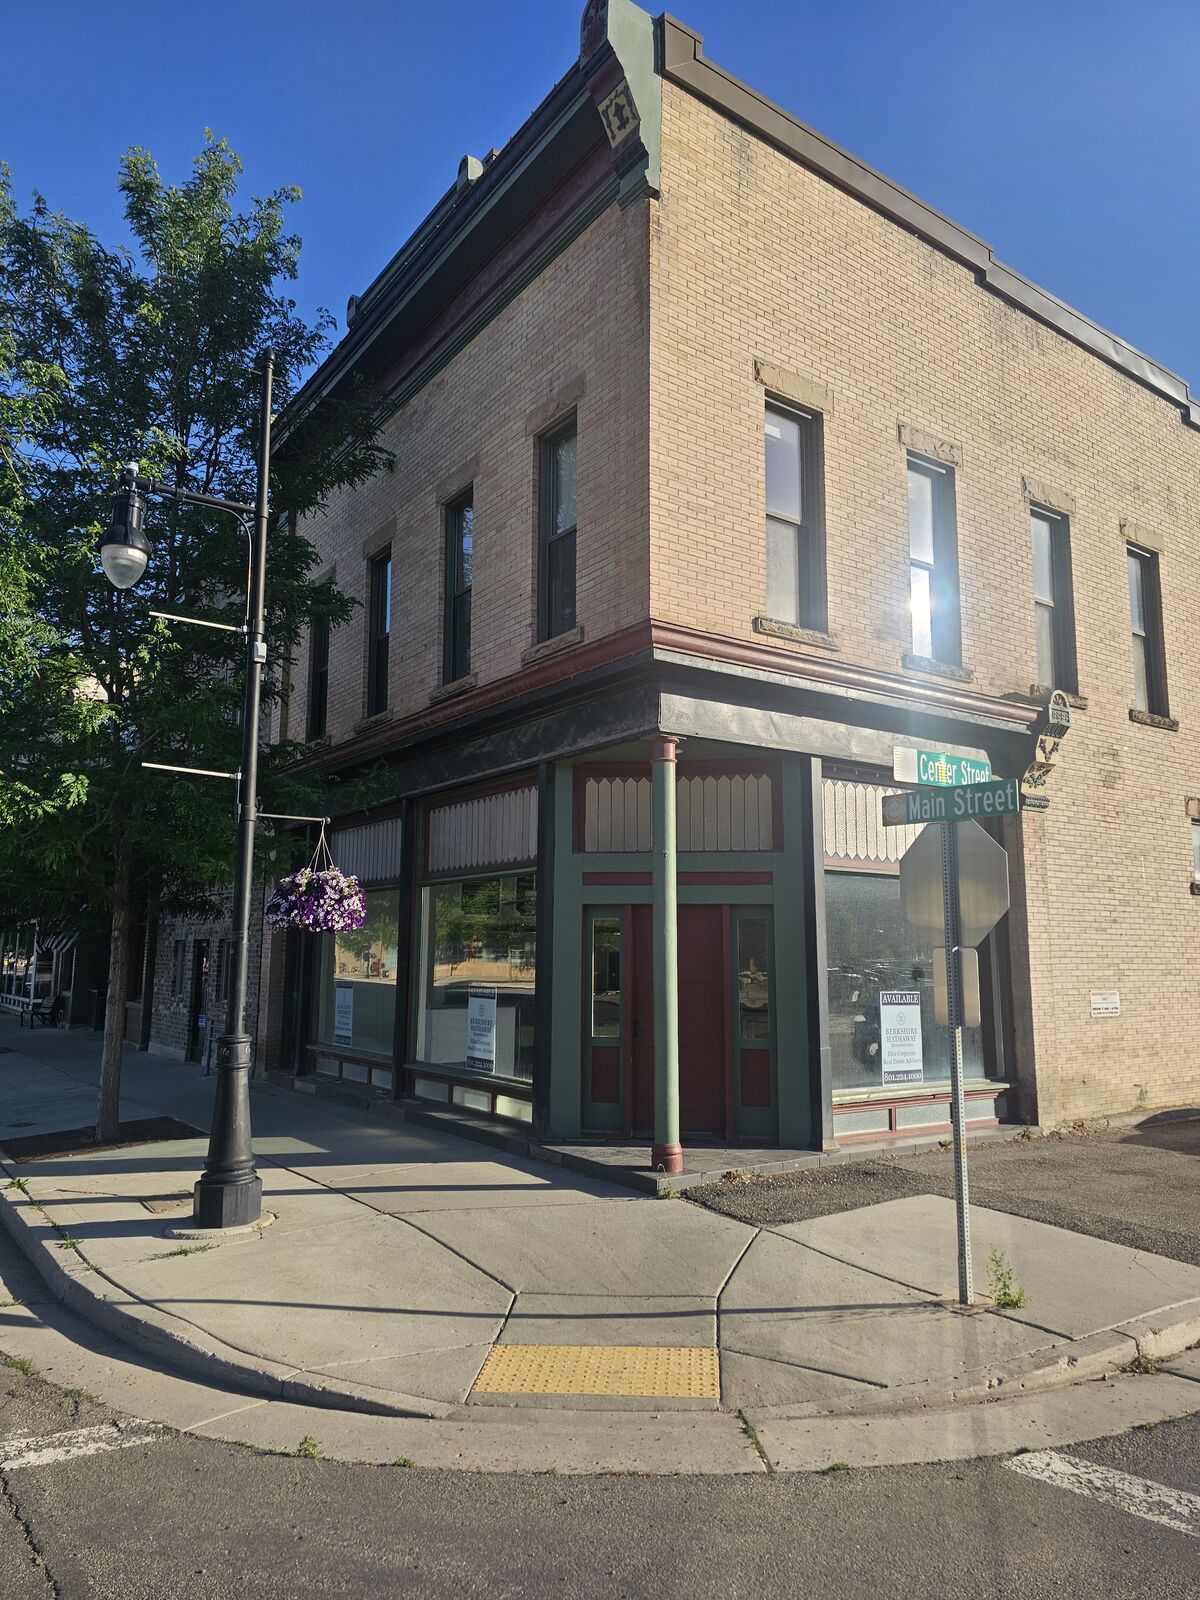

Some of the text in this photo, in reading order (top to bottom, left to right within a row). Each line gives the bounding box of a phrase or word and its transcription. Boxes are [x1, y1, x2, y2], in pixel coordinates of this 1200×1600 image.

[920, 754, 989, 785] Center Street
[909, 784, 1014, 821] Main Street
[883, 994, 919, 1003] AVAILABLE
[886, 1035, 917, 1043] HATHAWAY
[884, 1073, 921, 1081] 801.224.1000
